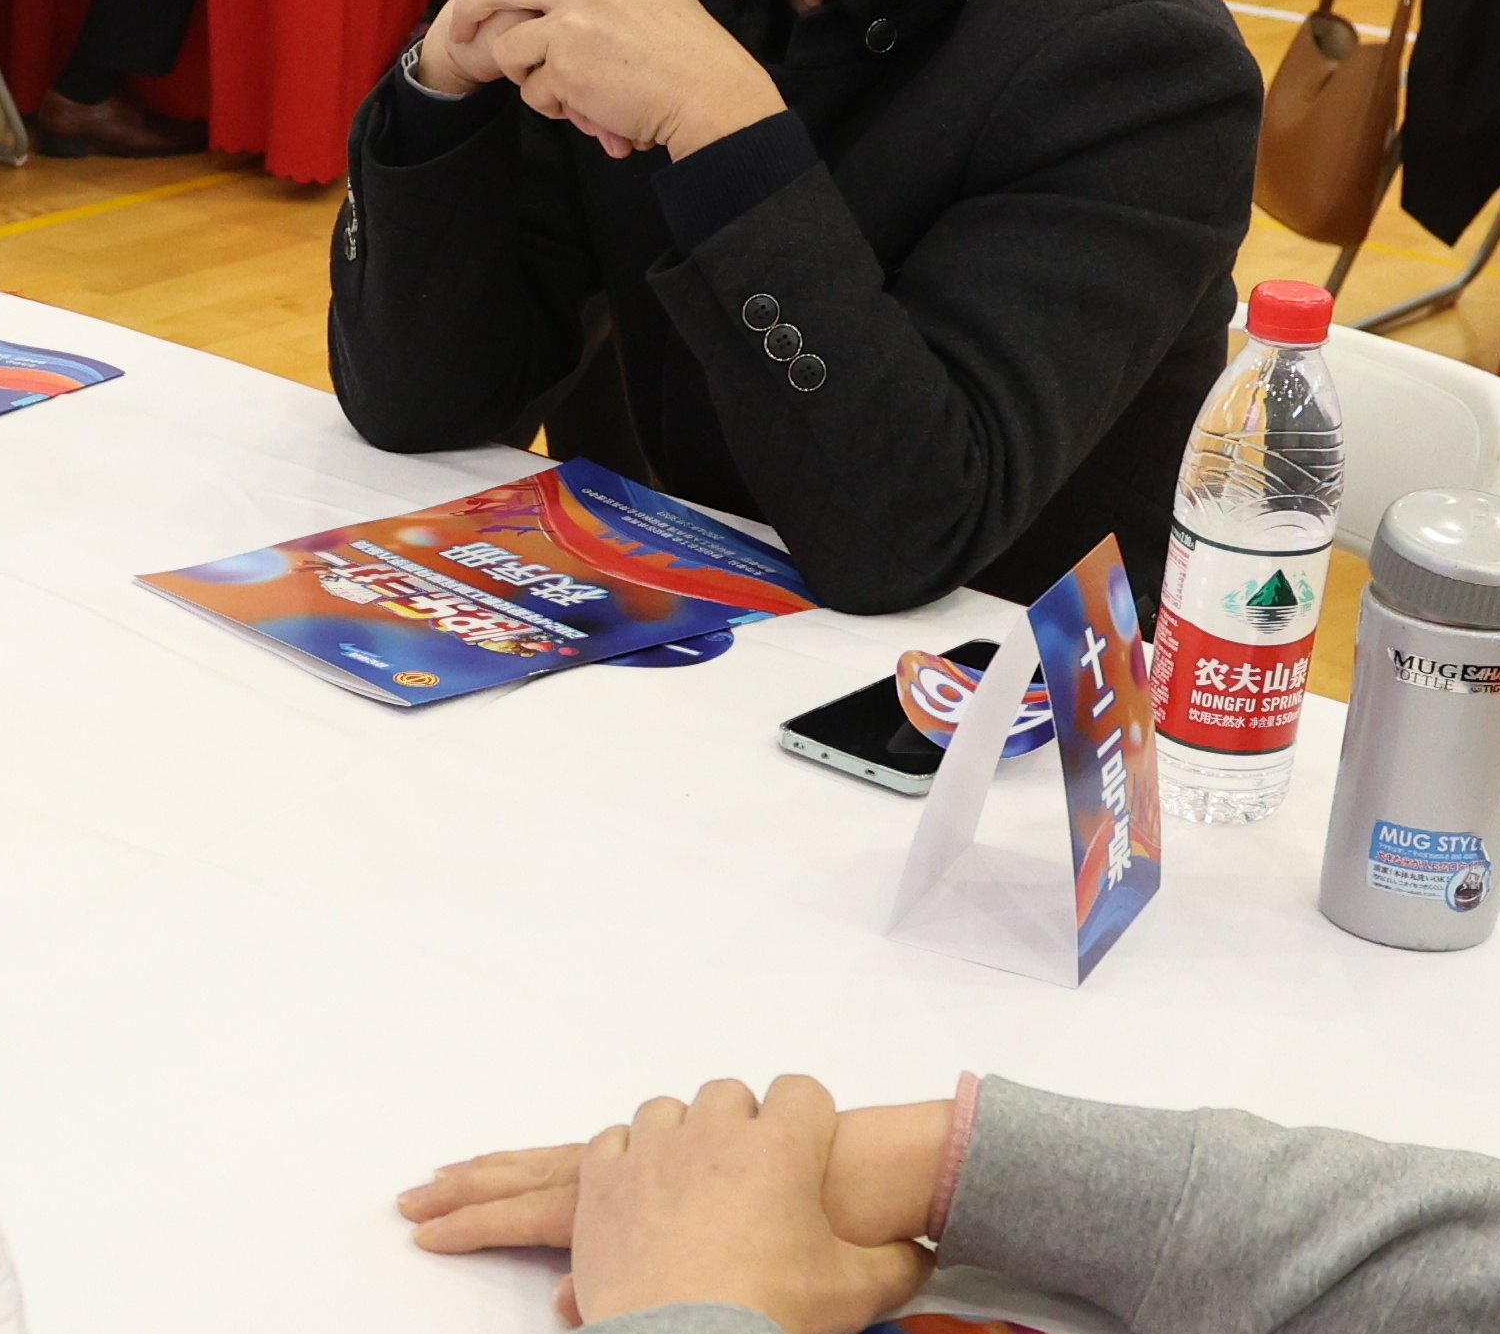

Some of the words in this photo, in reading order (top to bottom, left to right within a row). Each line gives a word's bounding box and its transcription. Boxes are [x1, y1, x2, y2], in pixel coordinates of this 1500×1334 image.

[438, 541, 610, 607] 秩序册
[1193, 657, 1310, 694] 农夫山泉
[1393, 649, 1458, 679] MUG
[1191, 689, 1256, 713] NONGFU
[1188, 707, 1246, 729] 饮用天然水
[1080, 626, 1133, 891] 十二号桌
[1379, 825, 1431, 850] MUG
[1437, 835, 1482, 852] STYL
